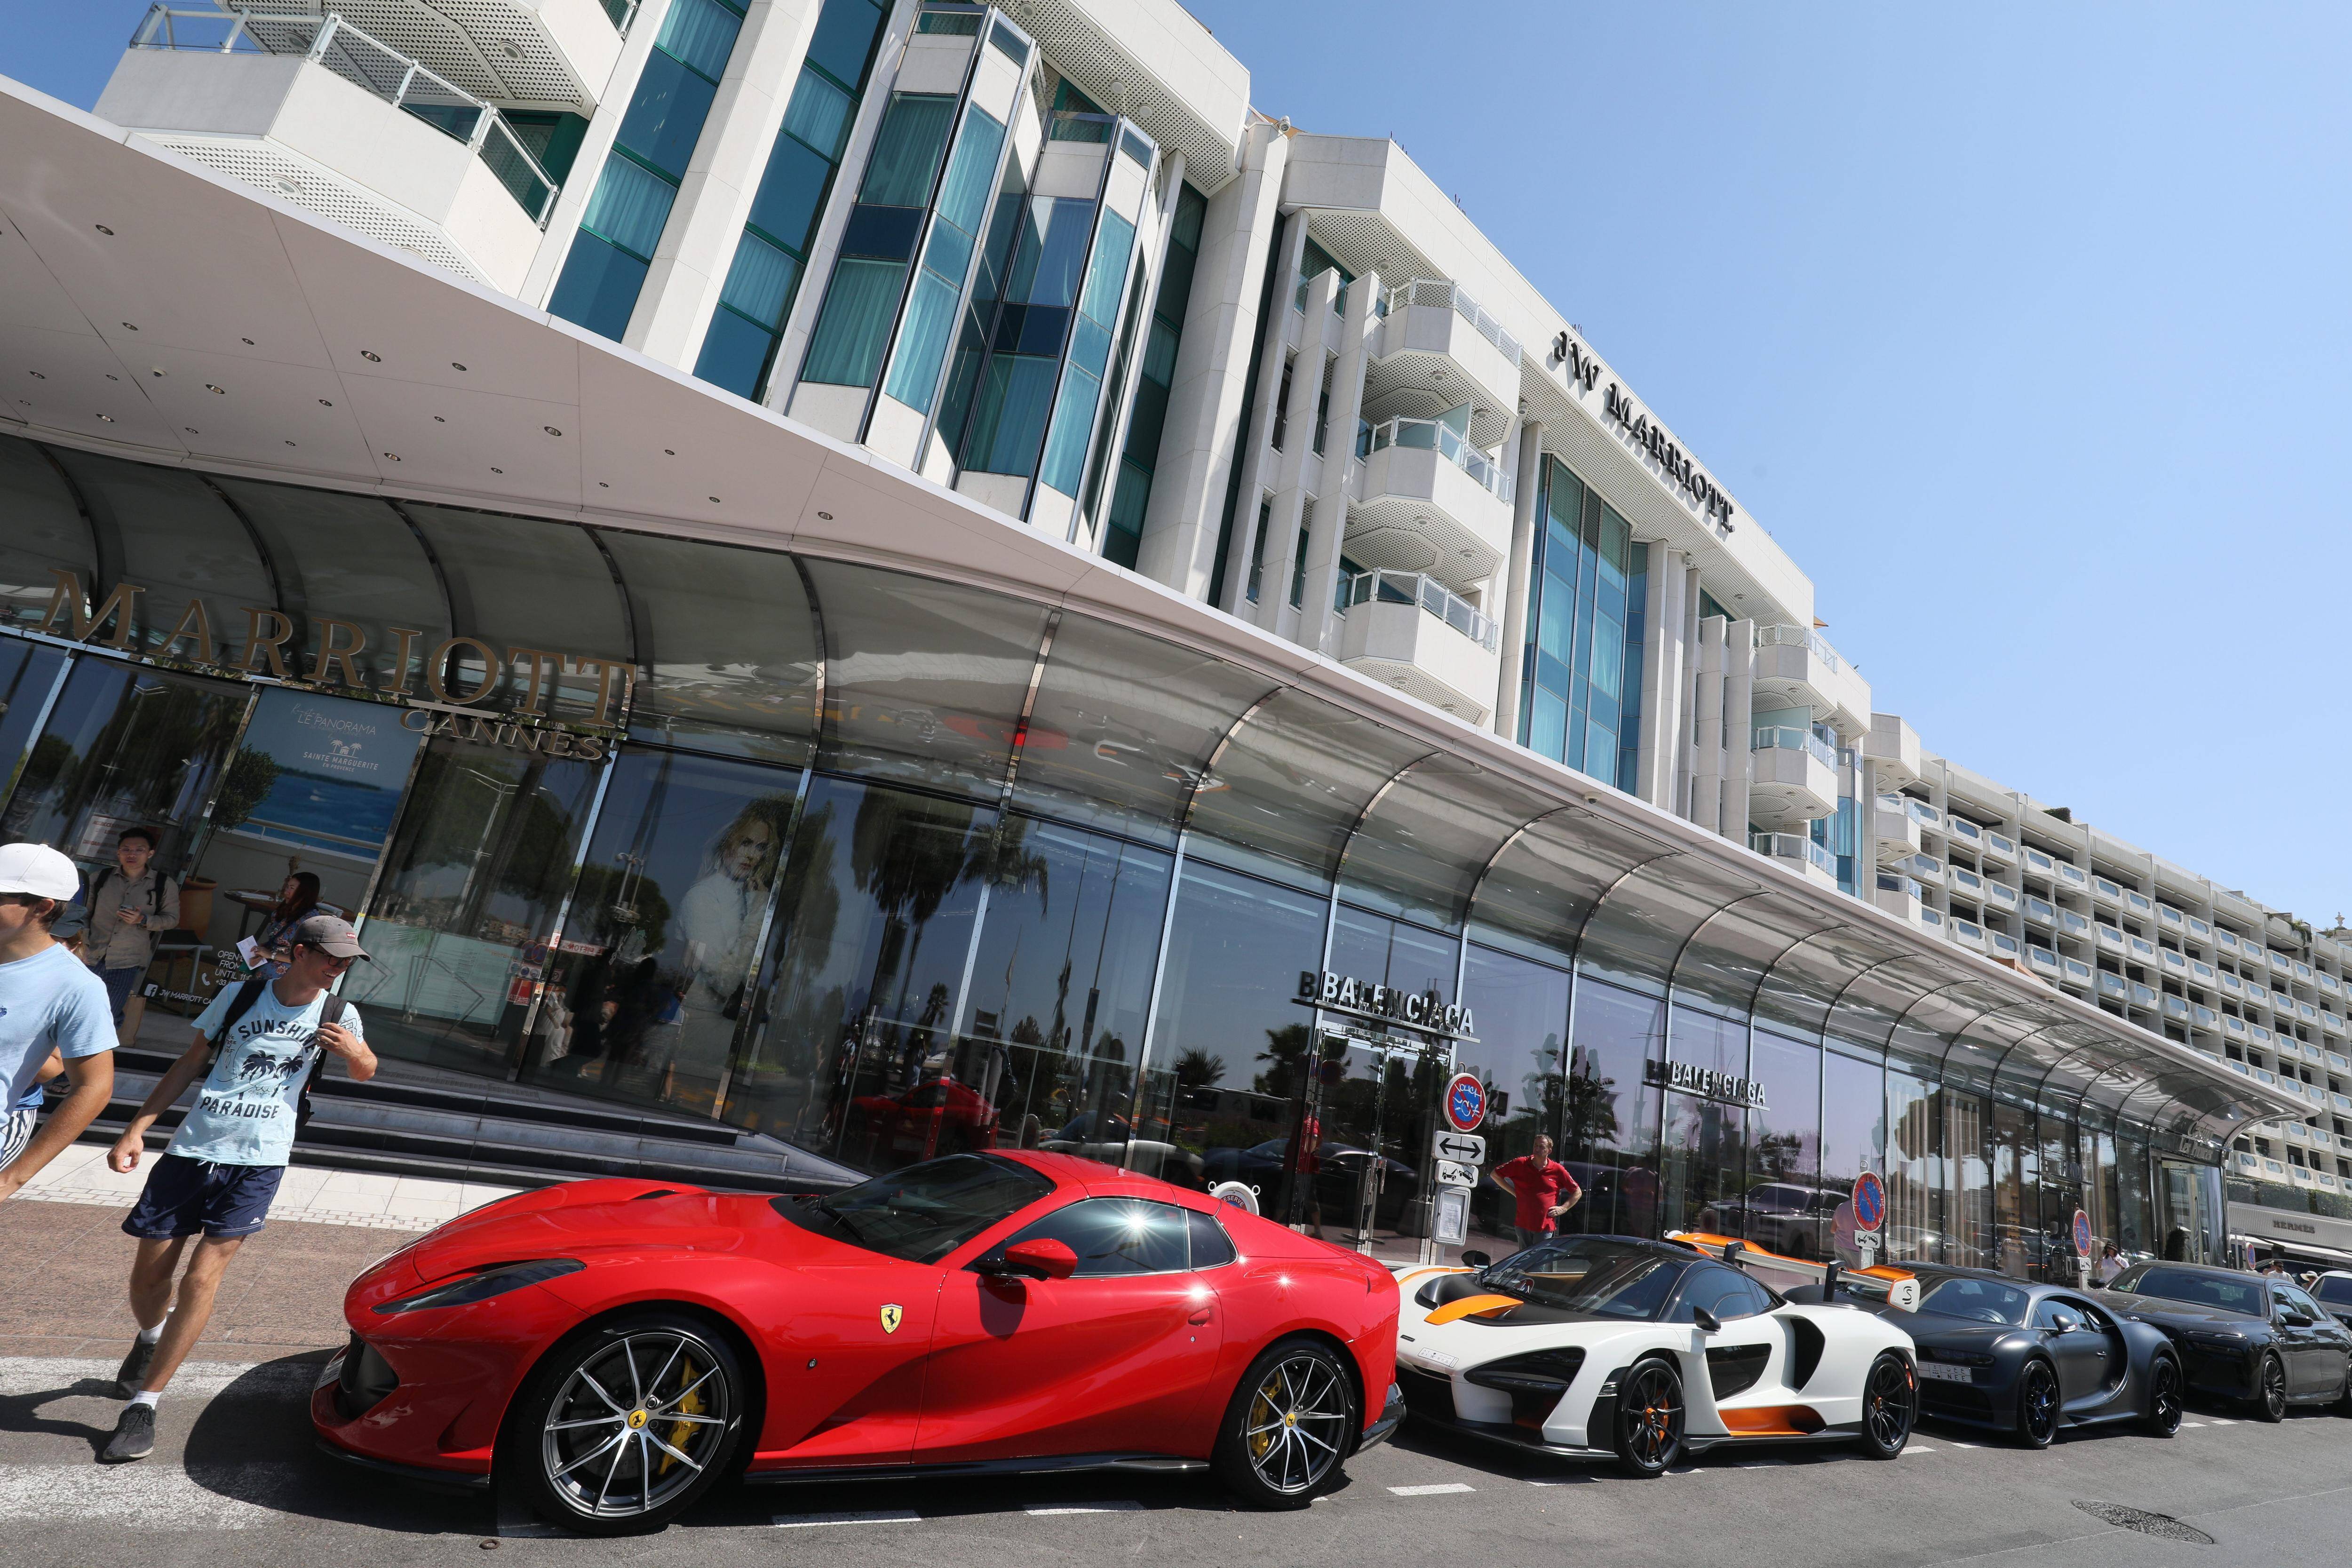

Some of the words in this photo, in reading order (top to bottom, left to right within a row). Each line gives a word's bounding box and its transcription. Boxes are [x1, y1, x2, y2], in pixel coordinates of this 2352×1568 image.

[1554, 330, 1603, 391] JW
[33, 568, 636, 730] MARRIOTT
[298, 714, 312, 724] LE
[314, 716, 376, 735] PANORAMA
[399, 709, 604, 761] CANNES
[303, 752, 329, 762] SAINTE
[332, 757, 378, 770] MARGUERITE
[218, 950, 239, 961] OPEN
[215, 968, 237, 979] UNTIL
[171, 992, 202, 1003] MARRIOTT
[1322, 971, 1474, 1034] BALENCIAGA
[238, 1019, 317, 1054] SUNSHINE
[1670, 1060, 1766, 1103] BALENCIAGA
[199, 1096, 279, 1119] PARADISE
[1223, 1195, 1244, 1207] ESERVE
[1947, 1373, 1966, 1382] NEE
